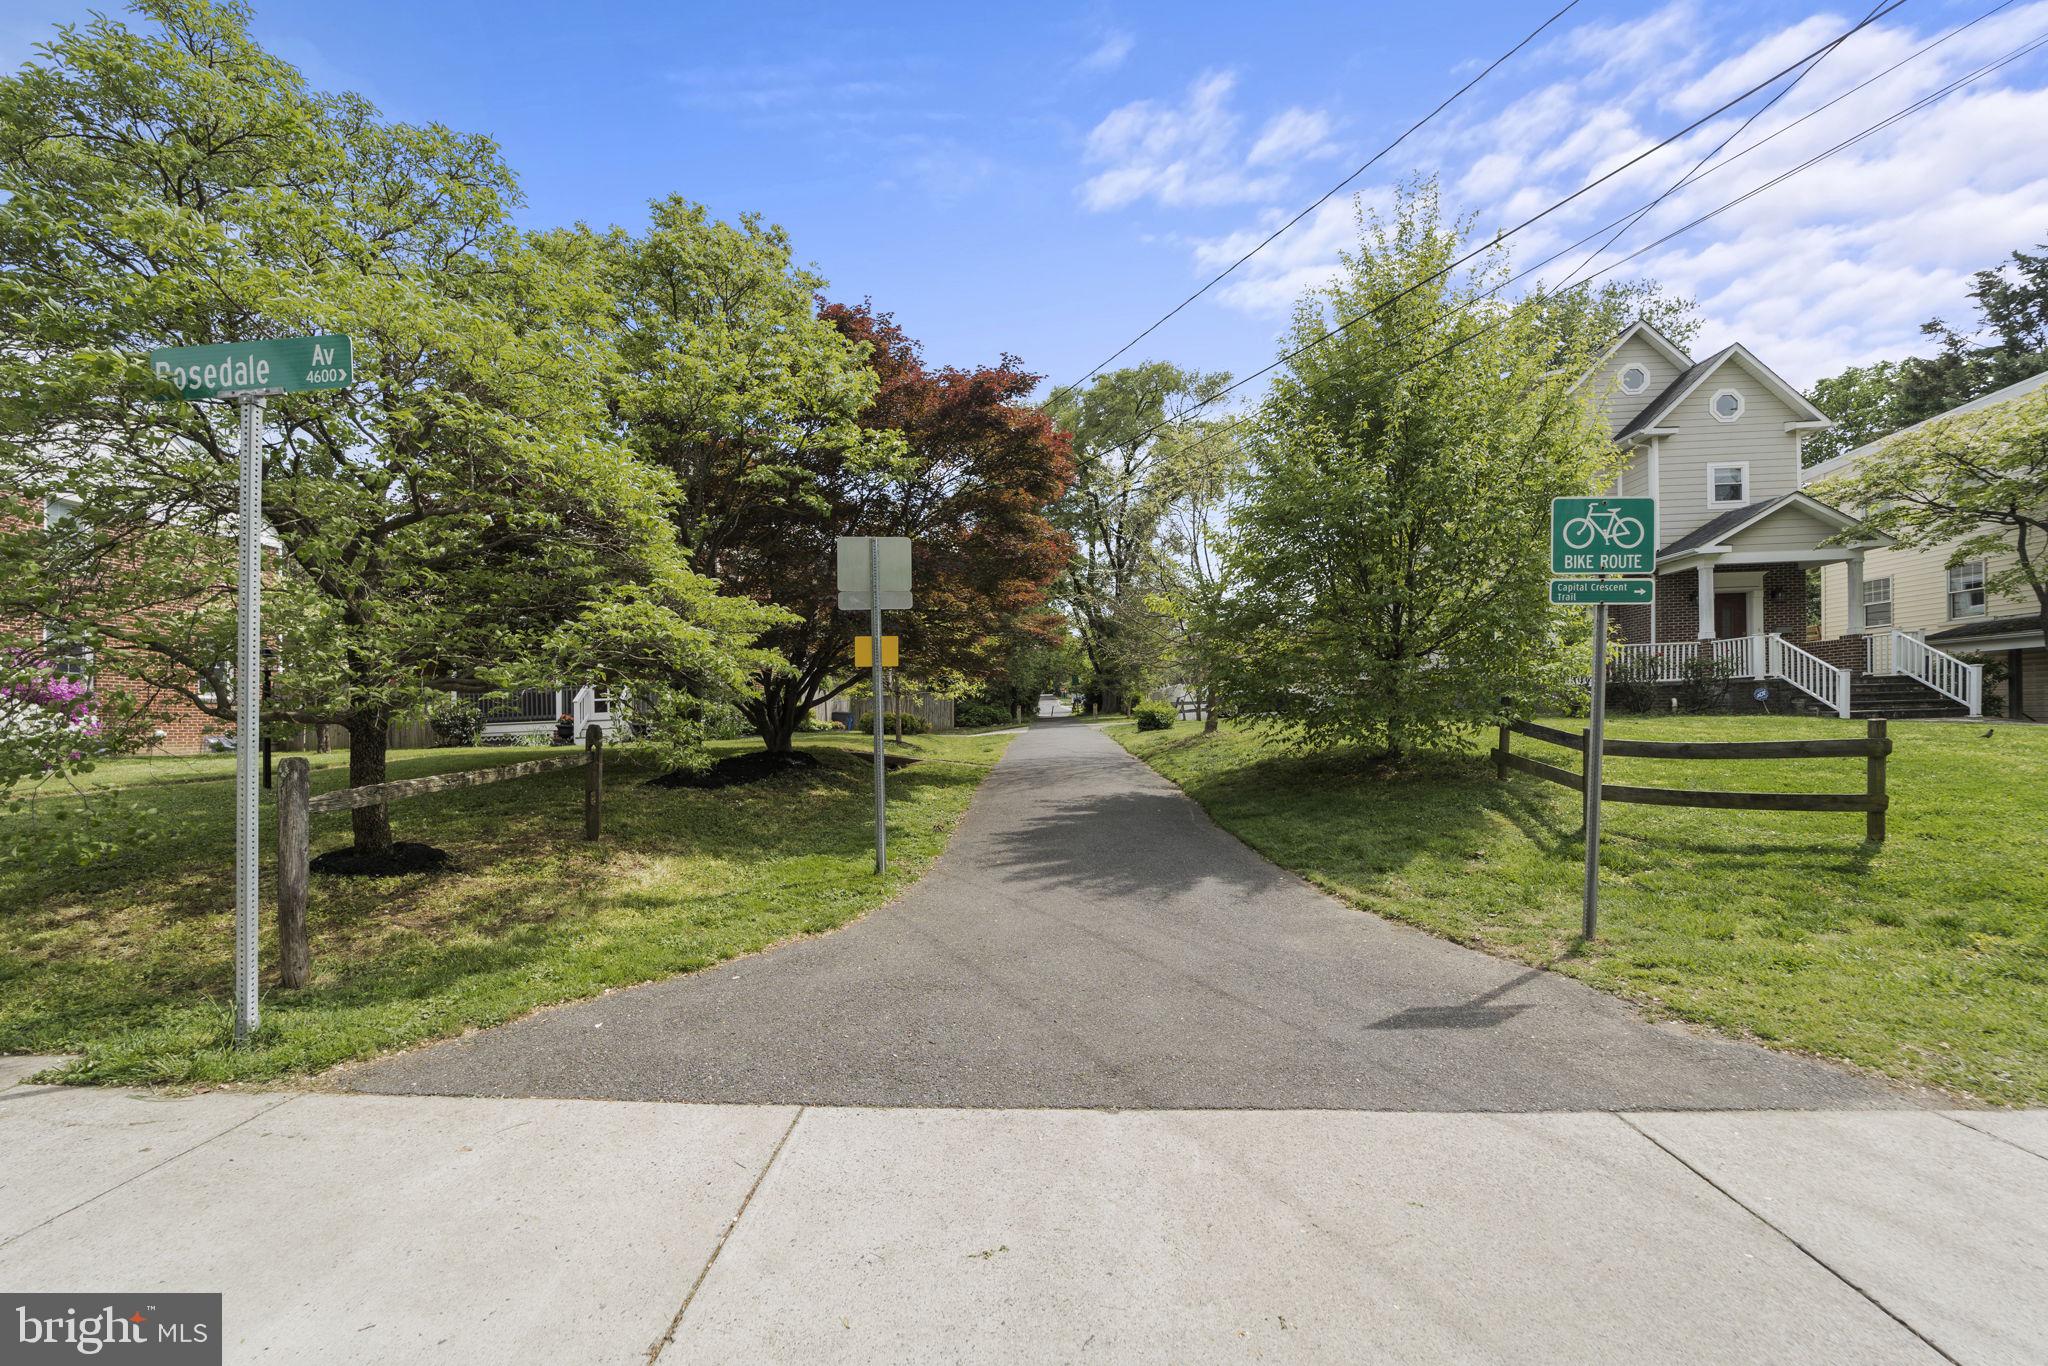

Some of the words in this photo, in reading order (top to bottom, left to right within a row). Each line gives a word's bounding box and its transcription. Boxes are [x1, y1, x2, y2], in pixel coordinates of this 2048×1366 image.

[312, 344, 334, 367] Av
[305, 369, 337, 384] 4600
[1564, 554, 1594, 569] BIKE
[1600, 554, 1642, 569] ROUTE
[1557, 583, 1588, 593] Capital
[1590, 583, 1628, 592] Crescent
[1557, 593, 1577, 601] Trail
